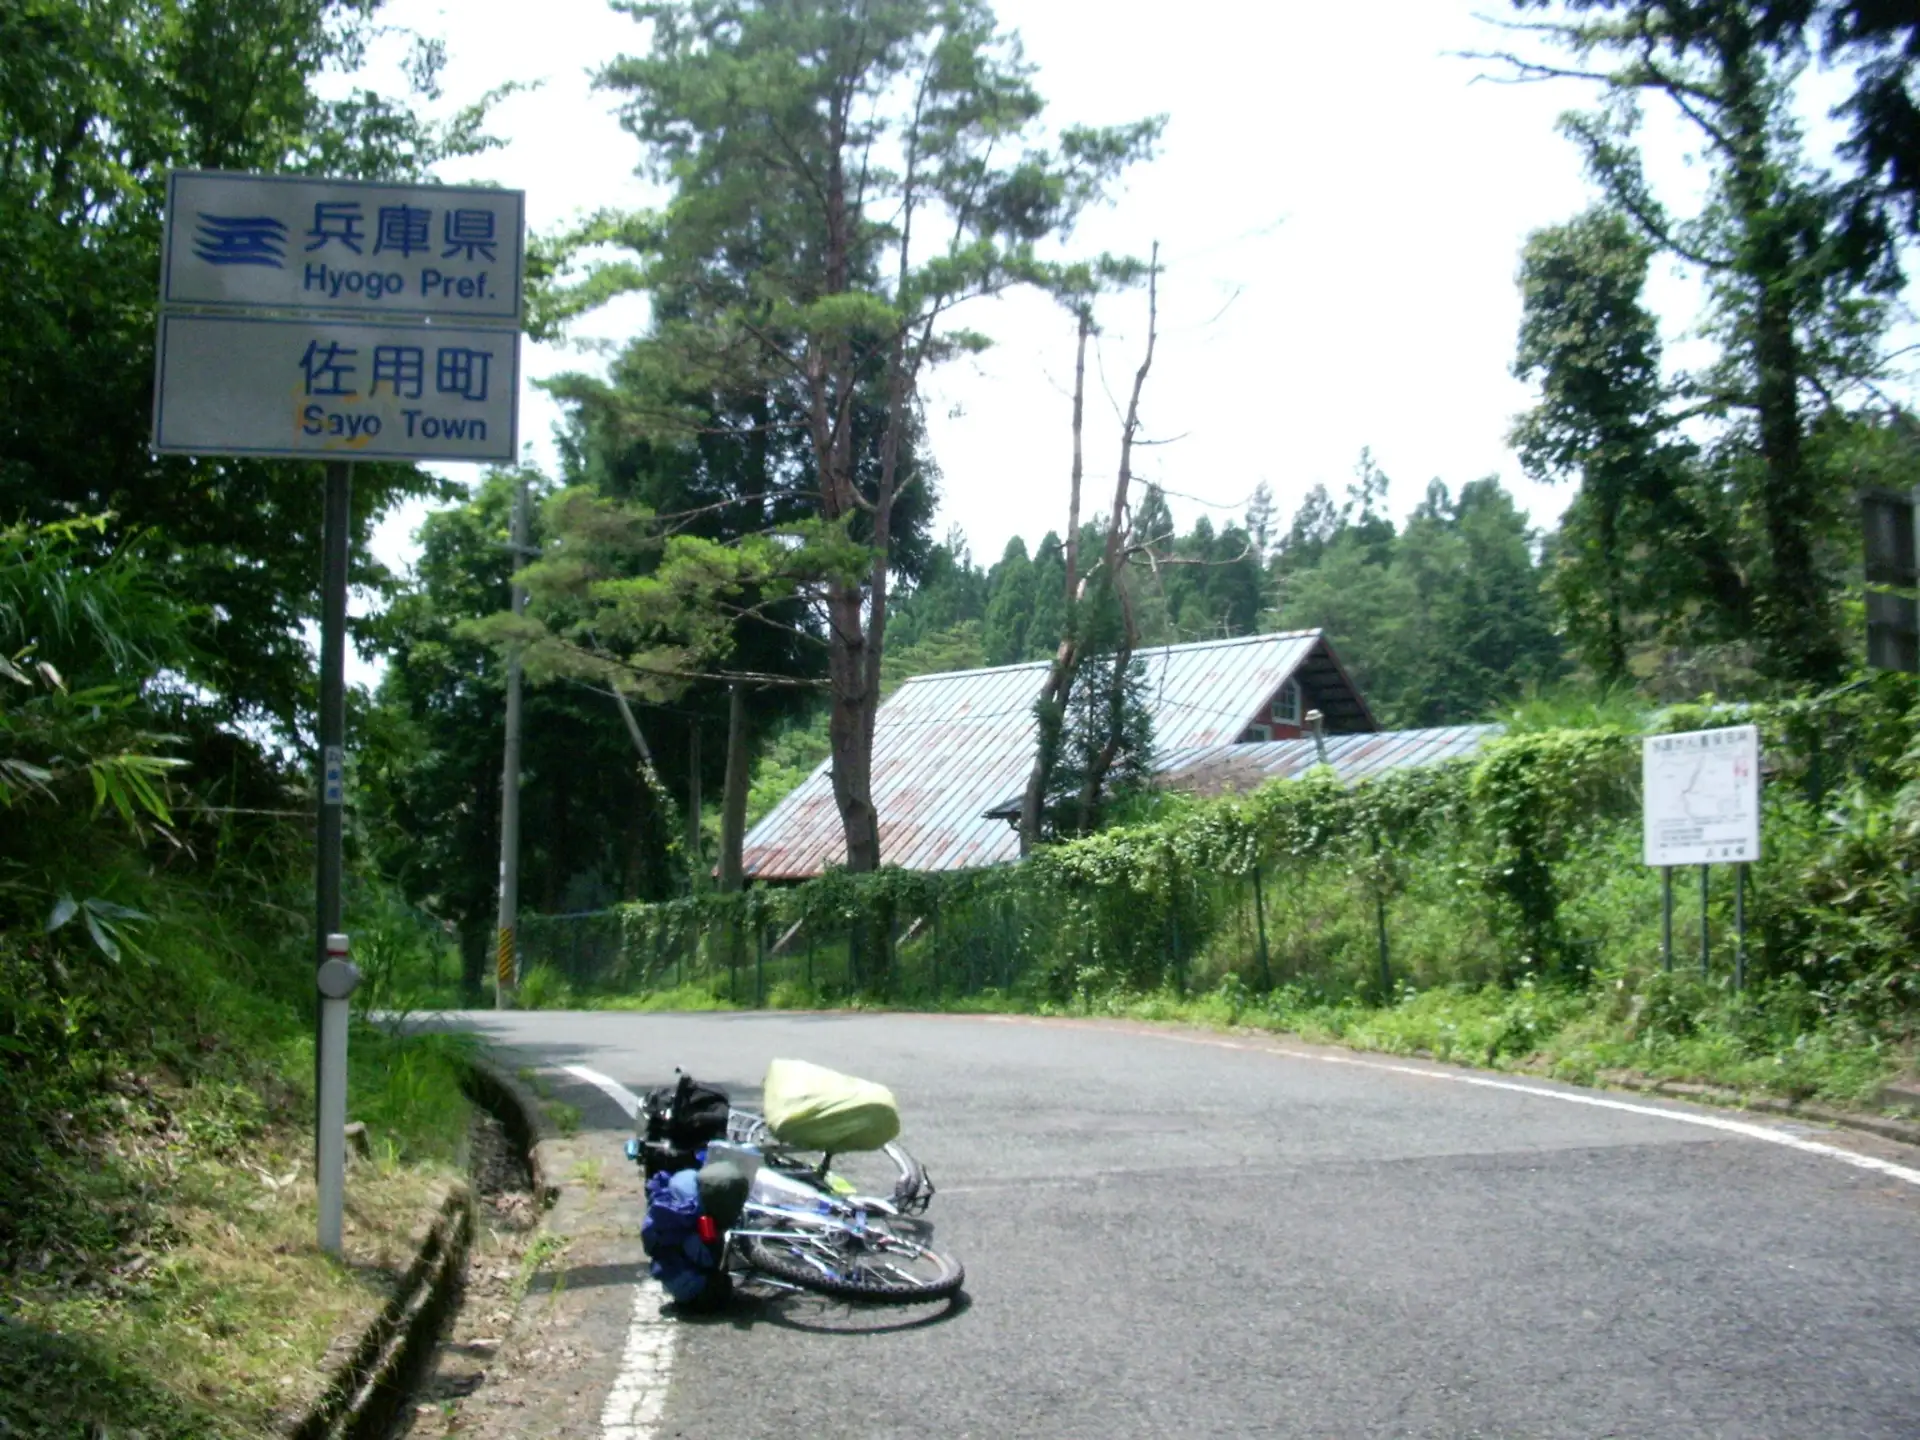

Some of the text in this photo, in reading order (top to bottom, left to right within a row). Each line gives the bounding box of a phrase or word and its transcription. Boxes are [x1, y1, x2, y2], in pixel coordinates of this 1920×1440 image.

[304, 202, 497, 263] 兵庫県
[303, 263, 495, 299] Hyogo Pref.
[299, 339, 494, 402] 佐用町
[303, 405, 487, 441] Sayo Town
